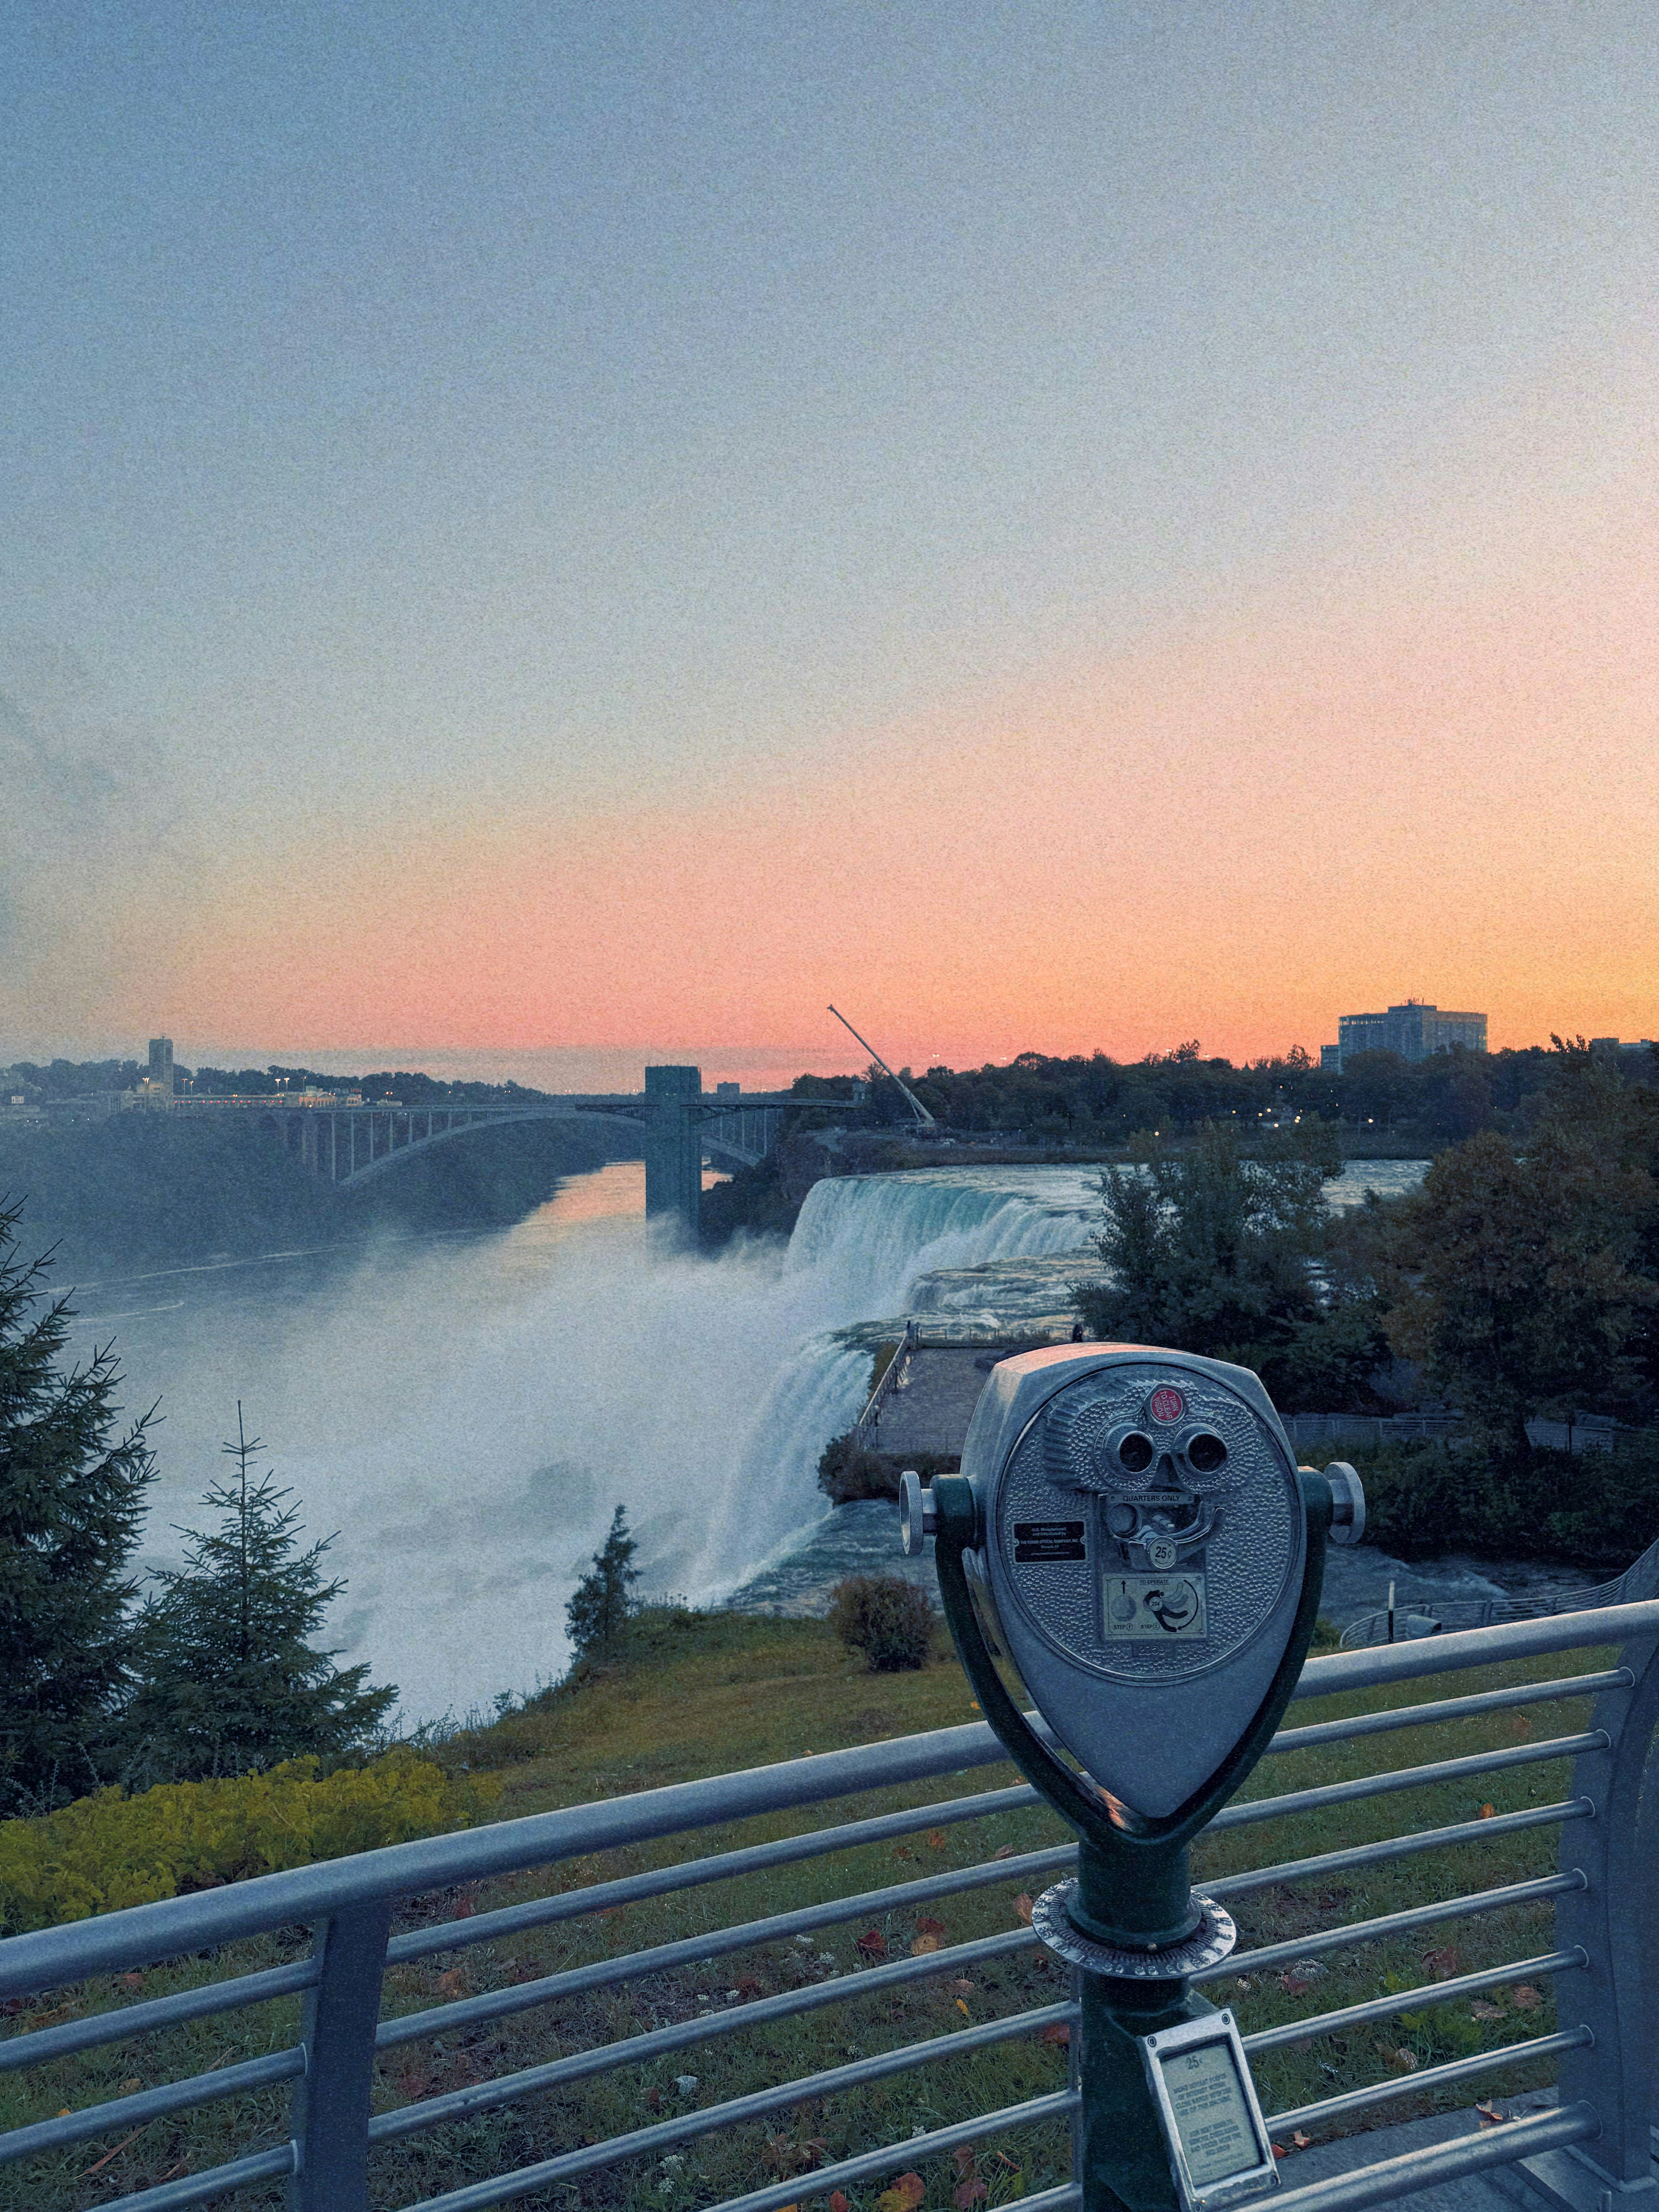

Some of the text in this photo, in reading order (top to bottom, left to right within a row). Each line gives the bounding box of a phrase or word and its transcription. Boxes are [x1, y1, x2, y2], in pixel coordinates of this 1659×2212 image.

[1152, 1397, 1164, 1417] VISION
[1160, 1391, 1173, 1419] TO CLEAR
[1170, 1395, 1179, 1411] TURN
